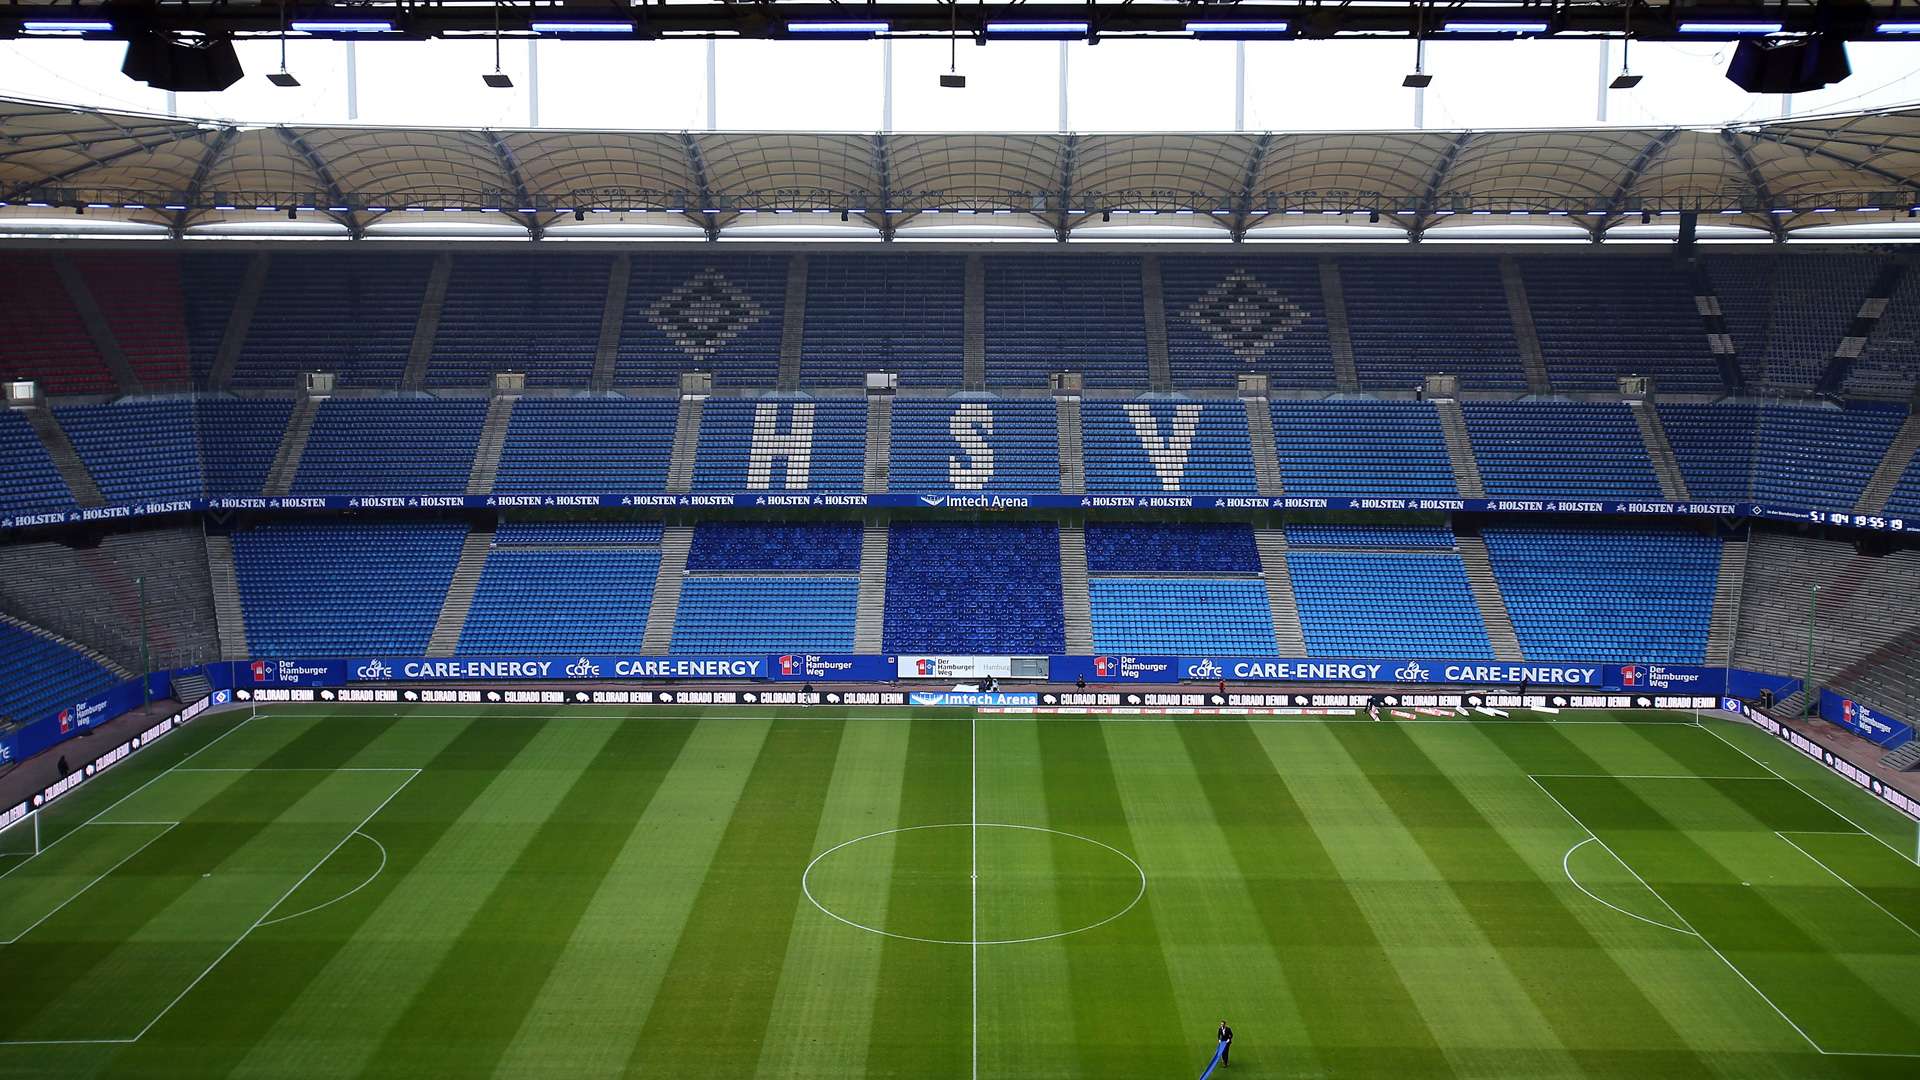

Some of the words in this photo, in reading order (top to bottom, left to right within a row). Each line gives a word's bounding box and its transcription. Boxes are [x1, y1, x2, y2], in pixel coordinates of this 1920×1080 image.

[747, 404, 815, 490] H
[949, 404, 994, 490] S
[1123, 405, 1203, 490] V
[222, 498, 265, 508] HOLSTEN
[282, 498, 325, 508] HOLSTEN
[362, 498, 404, 506] HOLSTEN
[421, 498, 463, 506] HOLSTEN
[499, 496, 541, 506] HOLSTEN
[556, 496, 599, 504] HOLSTEN
[634, 496, 676, 504] HOLSTEN
[692, 496, 733, 504] HOLSTEN
[768, 496, 810, 504] HOLSTEN
[826, 496, 867, 504] HOLSTEN
[946, 495, 988, 507] Imtech
[992, 495, 1028, 507] Arena
[1092, 498, 1134, 506] HOLSTEN
[1150, 498, 1192, 506] HOLSTEN
[1227, 498, 1269, 508] HOLSTEN
[1285, 498, 1327, 508] HOLSTEN
[1362, 500, 1404, 508] HOLSTEN
[1420, 500, 1464, 510] HOLSTEN
[1499, 502, 1542, 510] HOLSTEN
[1558, 502, 1602, 512] HOLSTEN
[1629, 504, 1673, 512] HOLSTEN
[1690, 504, 1734, 514] HOLSTEN
[279, 667, 327, 675] Hamburger
[405, 662, 551, 677] CARE-ENERGY
[616, 661, 760, 675] CARE-ENERGY
[806, 662, 852, 670] Hamburger
[1121, 663, 1167, 671] Hamburger
[1234, 663, 1381, 679] CARE-ENERGY
[1445, 666, 1595, 682] CARE-ENERGY
[1650, 673, 1698, 682] Hamburger
[254, 690, 290, 701] COLORADO
[291, 690, 314, 701] DENIM
[338, 690, 374, 701] COLORADO
[375, 690, 398, 701] DENIM
[422, 691, 457, 702] COLORADO
[458, 691, 481, 702] DENIM
[505, 691, 540, 702] COLORADO
[542, 691, 564, 702] DENIM
[593, 692, 629, 702] COLORADO
[630, 692, 652, 702] DENIM
[677, 692, 712, 703] COLORADO
[714, 692, 736, 703] DENIM
[761, 692, 796, 704] COLORADO
[844, 693, 879, 704] COLORADO
[881, 693, 903, 704] DENIM
[945, 693, 993, 705] Imtech
[997, 693, 1036, 705] Arena
[1061, 694, 1096, 705] COLORADO
[1098, 694, 1120, 705] DENIM
[1145, 694, 1181, 705] COLORADO
[1182, 694, 1204, 705] DENIM
[1229, 695, 1264, 705] COLORADO
[1266, 695, 1288, 705] DENIM
[1312, 695, 1348, 706] COLORADO
[1402, 696, 1437, 706] COLORADO
[1439, 696, 1462, 706] DENIM
[1486, 696, 1521, 707] COLORADO
[1523, 696, 1546, 707] DENIM
[1570, 696, 1606, 707] COLORADO
[1607, 696, 1631, 707] DENIM
[1655, 697, 1691, 708] COLORADO
[1692, 697, 1716, 708] DENIM
